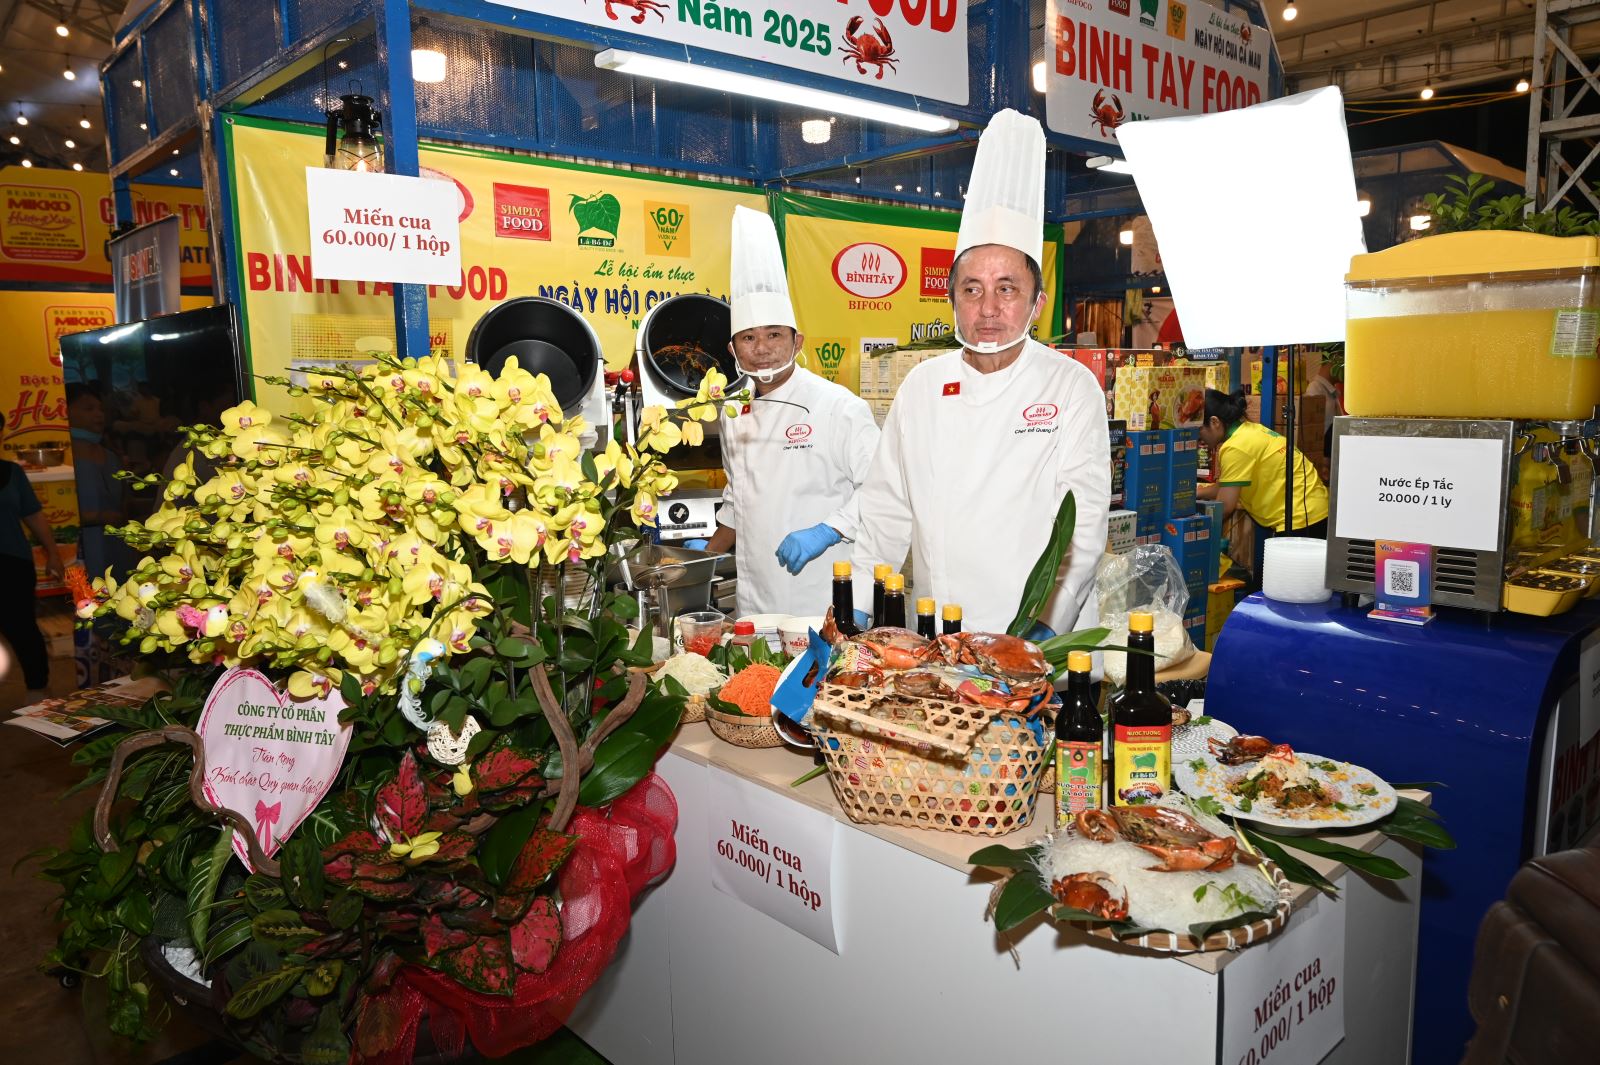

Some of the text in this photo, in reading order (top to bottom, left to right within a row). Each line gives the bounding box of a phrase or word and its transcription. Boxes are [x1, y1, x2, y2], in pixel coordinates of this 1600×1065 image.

[763, 9, 833, 57] 2025
[1055, 14, 1133, 94] BINH
[1142, 43, 1196, 110] TAY
[99, 197, 171, 227] CNG
[343, 208, 432, 231] Miến cua
[501, 204, 542, 218] SIMPLY
[502, 216, 544, 232] FOOD
[656, 207, 679, 228] 60
[322, 229, 451, 257] 60.000/ 1 hộp
[247, 252, 340, 295] BIN
[594, 259, 696, 285] Lễ hội ẩm thực
[538, 280, 599, 314] NGÀY
[604, 284, 640, 320] HỘI
[848, 300, 892, 312] BIFOCO
[821, 342, 841, 361] 60
[1379, 477, 1454, 491] Nước Ép Tắc
[1378, 492, 1452, 509] 20.000 / 1 ly
[238, 700, 326, 723] CÔNG TY CỔ PHẦN
[224, 722, 337, 746] THỰC PHẨM BÌNH TÂY
[731, 819, 802, 873] Miến cua
[717, 839, 822, 912] 60.000/ 1 hộp
[1253, 957, 1321, 1033] Miến cua
[1296, 1001, 1305, 1026] 1
[1307, 977, 1336, 1015] hộp
